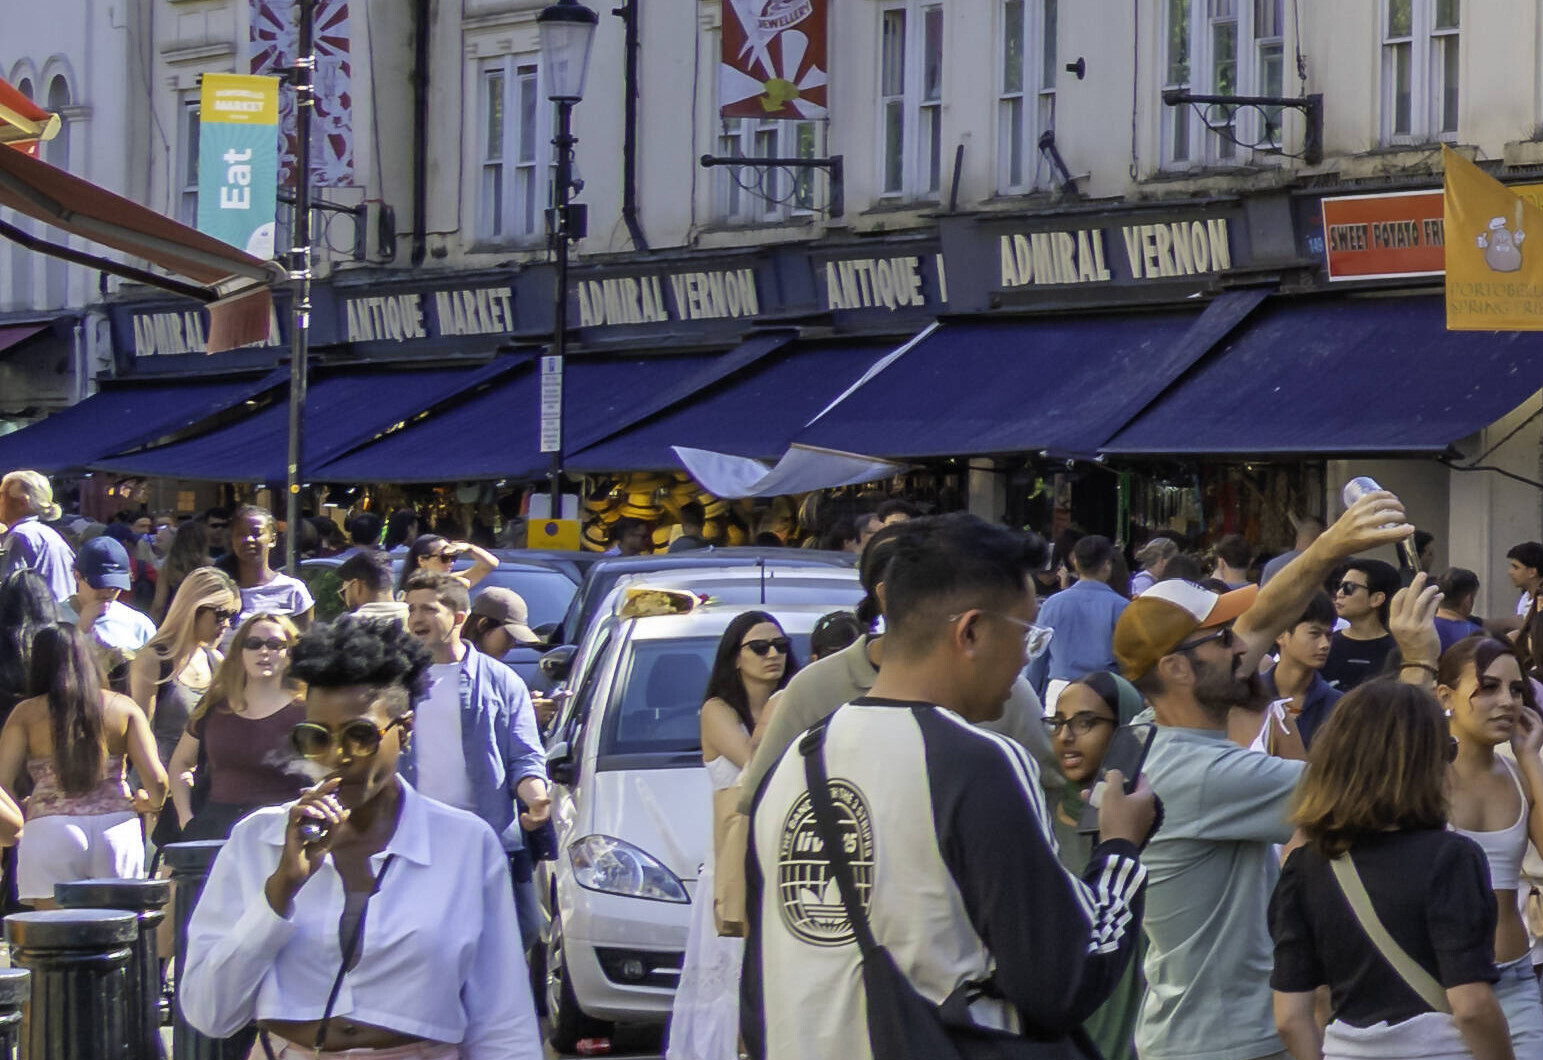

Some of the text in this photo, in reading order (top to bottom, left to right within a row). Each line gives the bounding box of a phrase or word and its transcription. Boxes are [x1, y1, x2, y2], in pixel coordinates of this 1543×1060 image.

[758, 1, 811, 29] JEWELLERY
[220, 148, 252, 210] Eat
[1000, 229, 1111, 287] ADMIRAL
[1122, 218, 1231, 278] VERNON
[1329, 218, 1444, 251] SWEET POTATO FRI
[578, 269, 759, 327] ADMIRAL VERNON
[826, 256, 925, 312] ANTIQUE
[1450, 299, 1509, 316] SPRING
[133, 310, 210, 357] ADMIRAL
[346, 287, 513, 343] ANTIQUE MARKET
[796, 831, 825, 852] liv
